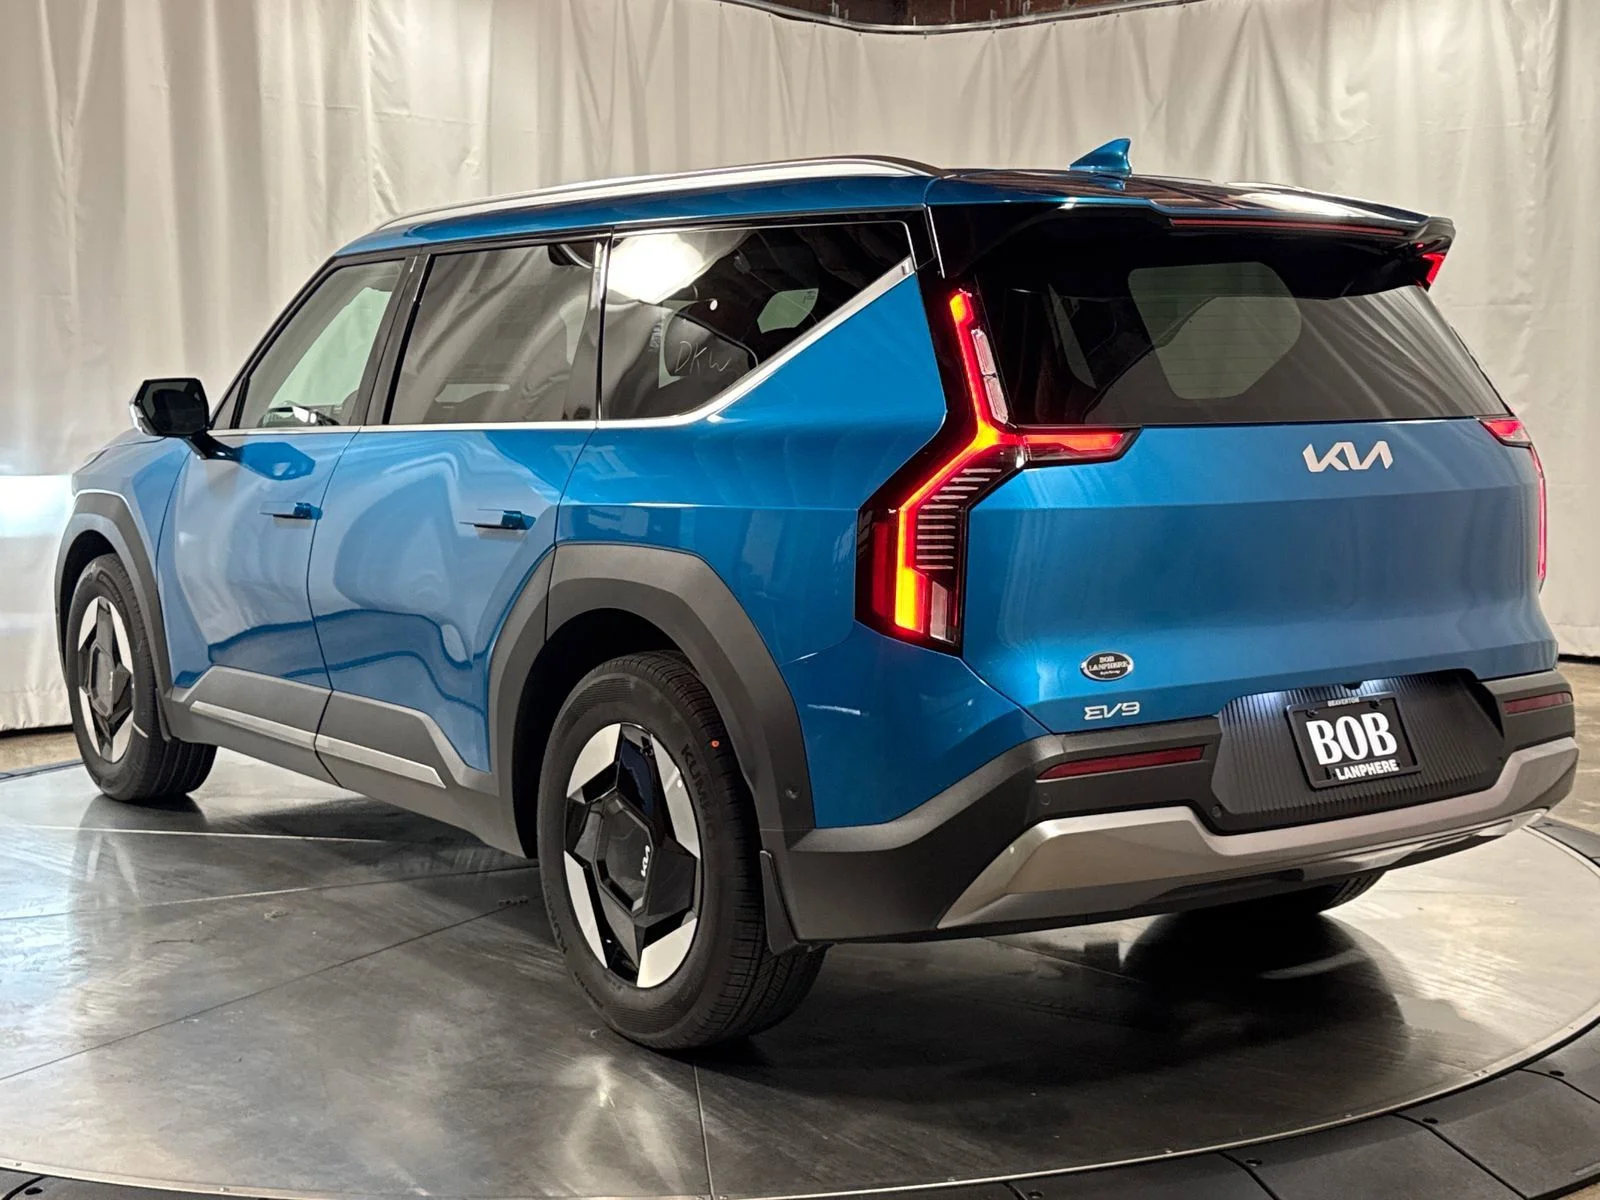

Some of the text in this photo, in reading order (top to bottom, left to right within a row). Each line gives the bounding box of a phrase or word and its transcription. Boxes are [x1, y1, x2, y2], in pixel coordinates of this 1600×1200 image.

[1302, 440, 1394, 472] KIA
[1084, 701, 1140, 721] EV9
[1305, 712, 1398, 766] BOB
[1334, 759, 1400, 781] LANPHERE
